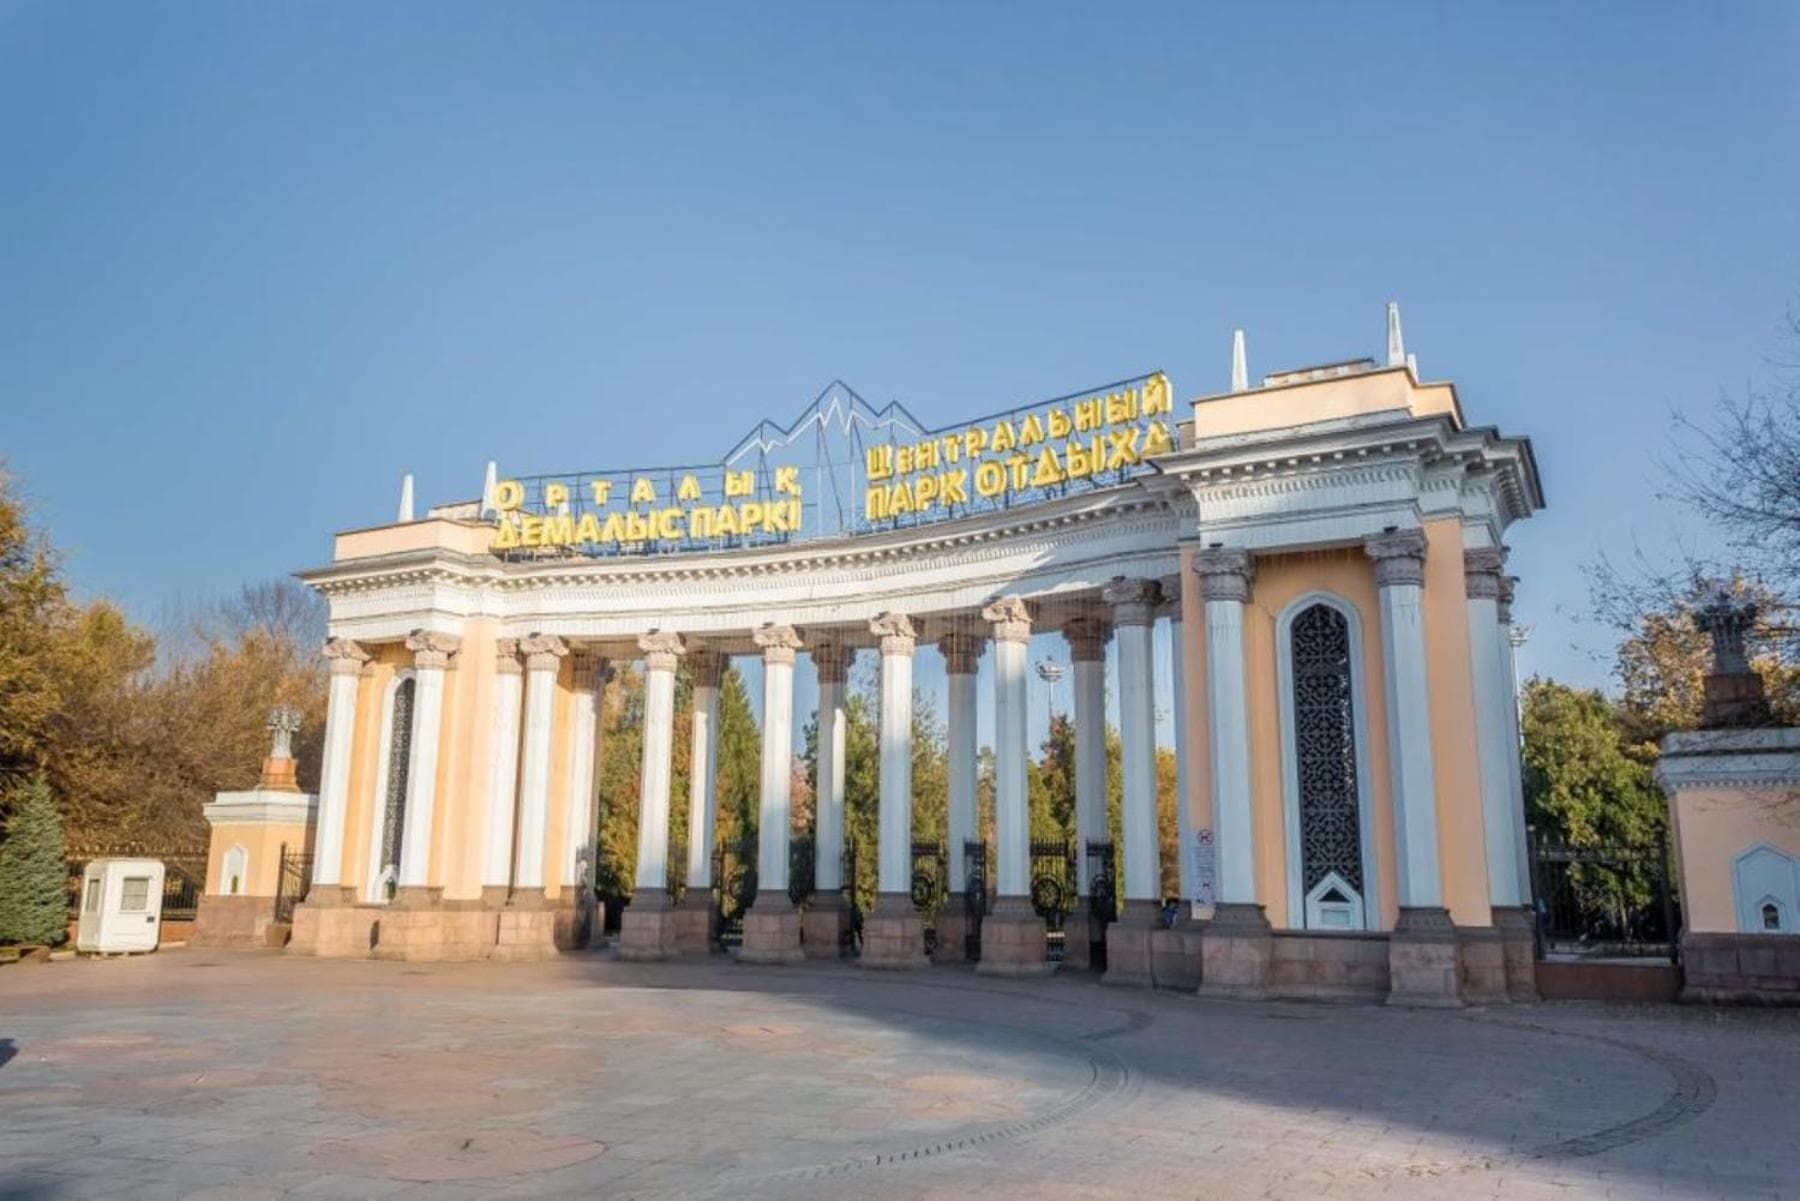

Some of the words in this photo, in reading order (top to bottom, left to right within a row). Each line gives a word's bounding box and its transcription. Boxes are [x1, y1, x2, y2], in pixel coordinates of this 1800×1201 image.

[866, 371, 1173, 480] ЦЕНТРАЛЬНЫЙ
[494, 465, 801, 510] ОРТАЛЫҚ
[865, 469, 967, 521] ПАРК
[976, 422, 1173, 497] ОТДЫХА
[489, 507, 685, 549] ДЕМАЛЫС
[690, 497, 801, 538] ПАРКІ
